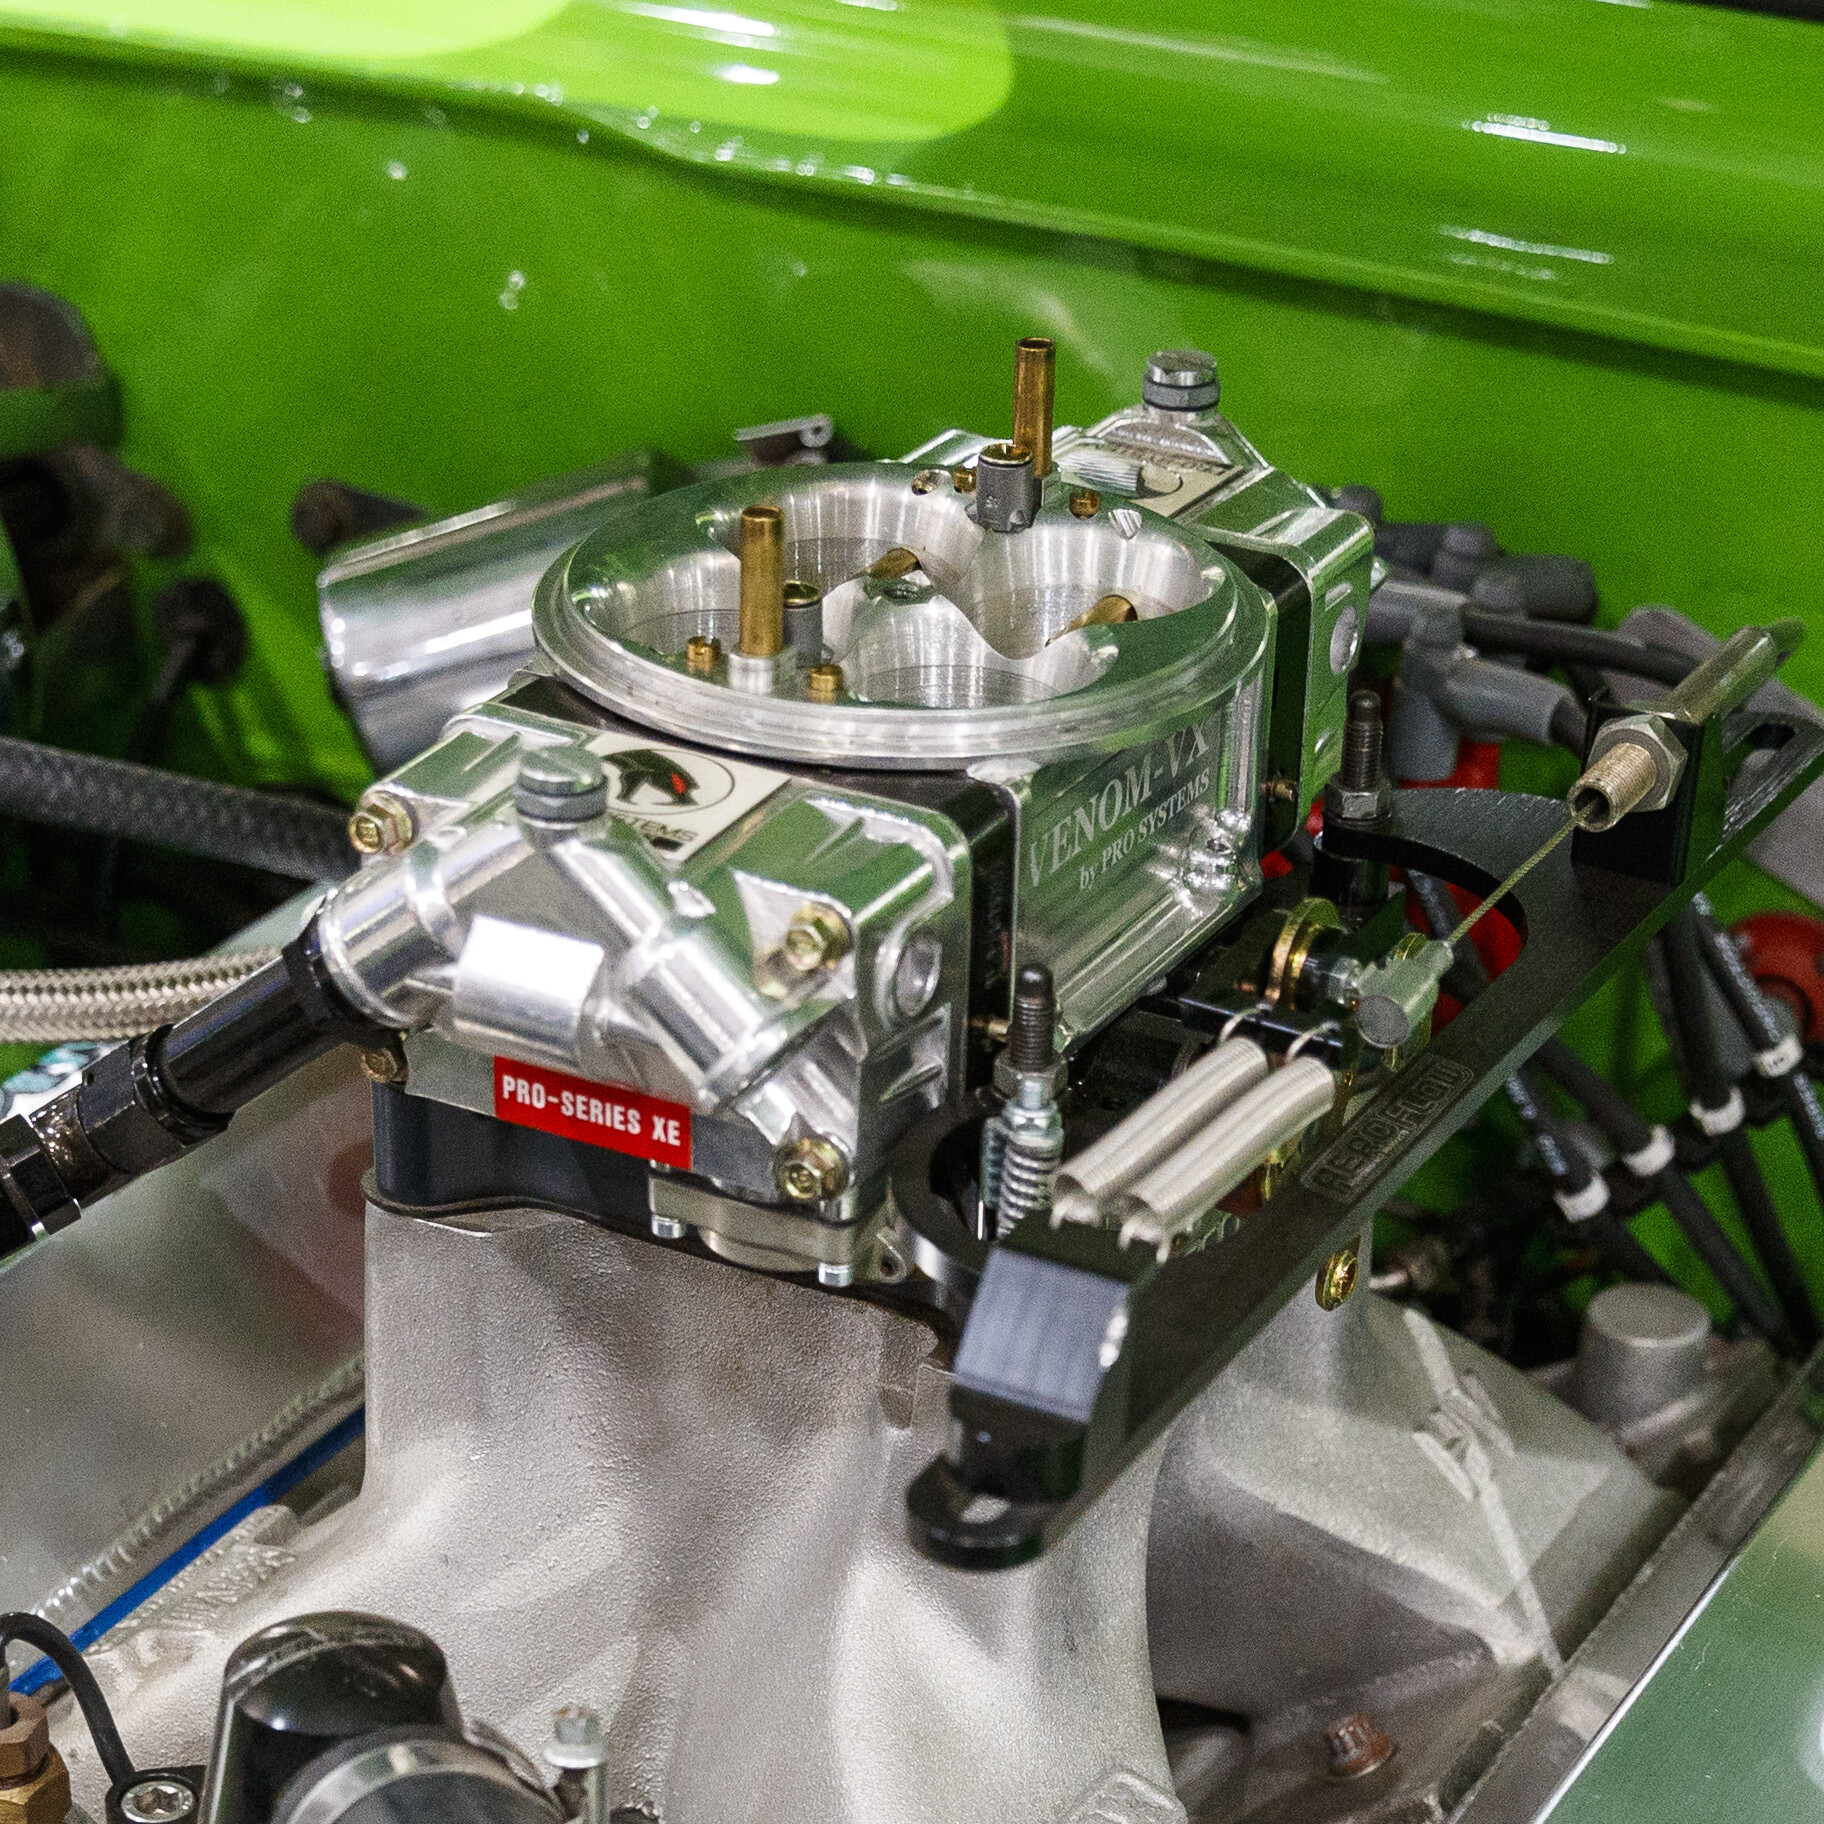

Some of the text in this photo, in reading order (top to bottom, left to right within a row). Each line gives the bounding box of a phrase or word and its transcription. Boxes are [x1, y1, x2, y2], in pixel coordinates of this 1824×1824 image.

[1028, 722, 1211, 888] VENOM-VX
[1078, 768, 1211, 892] by PRO SYSTEMS
[502, 1074, 681, 1147] PRO-SERIES XE
